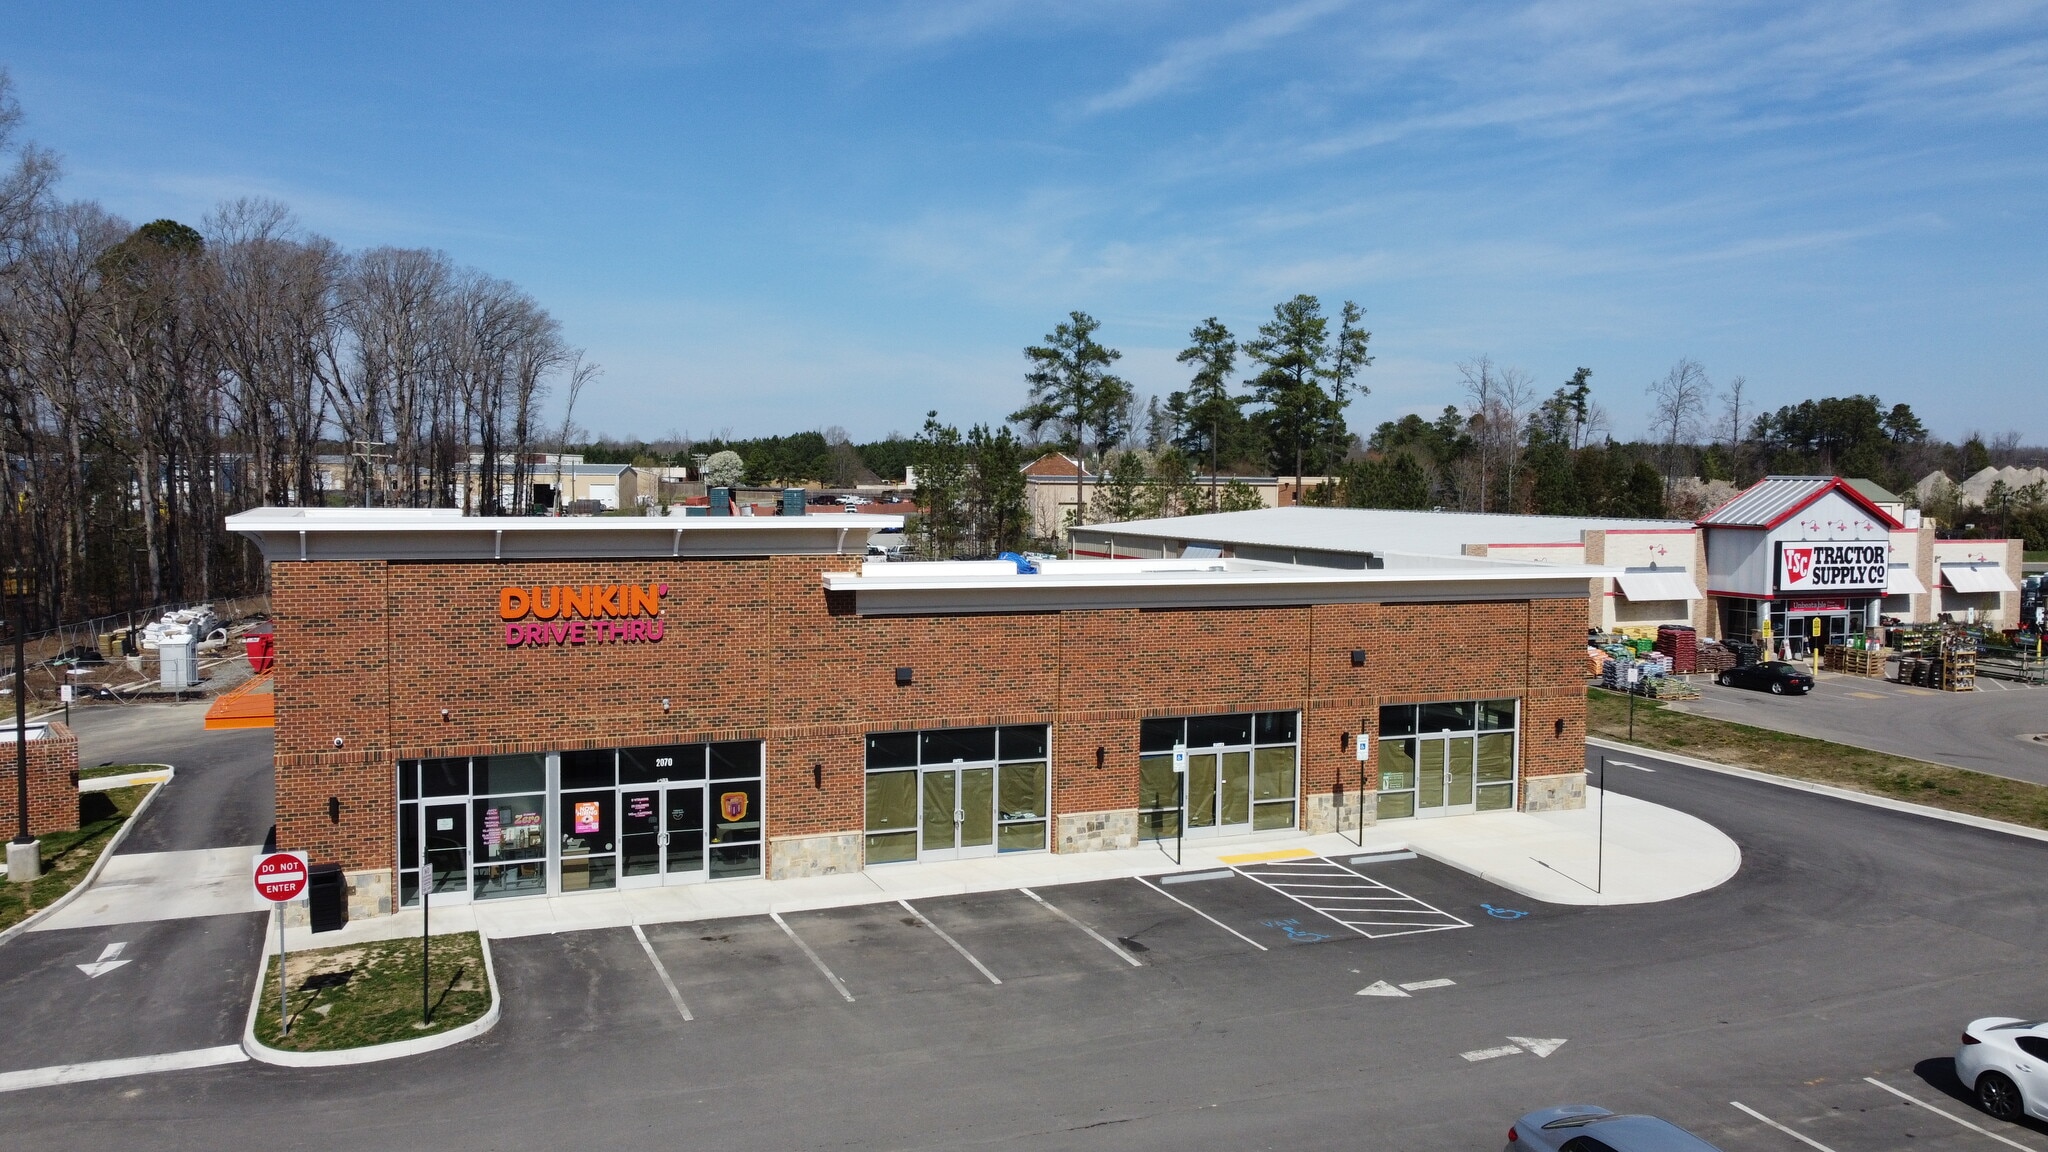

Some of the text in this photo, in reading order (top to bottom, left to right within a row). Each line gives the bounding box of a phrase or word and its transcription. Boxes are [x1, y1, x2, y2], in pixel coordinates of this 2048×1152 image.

[1786, 549, 1808, 577] TSC
[1813, 546, 1885, 565] TRACTOR
[1812, 566, 1867, 585] SUPPLY
[500, 584, 668, 619] DUNKIN'
[505, 619, 664, 645] DRIVE THRU
[656, 758, 673, 767] 2070
[514, 815, 541, 825] Zero
[262, 862, 299, 873] DO NOT
[266, 883, 296, 893] ENTER
